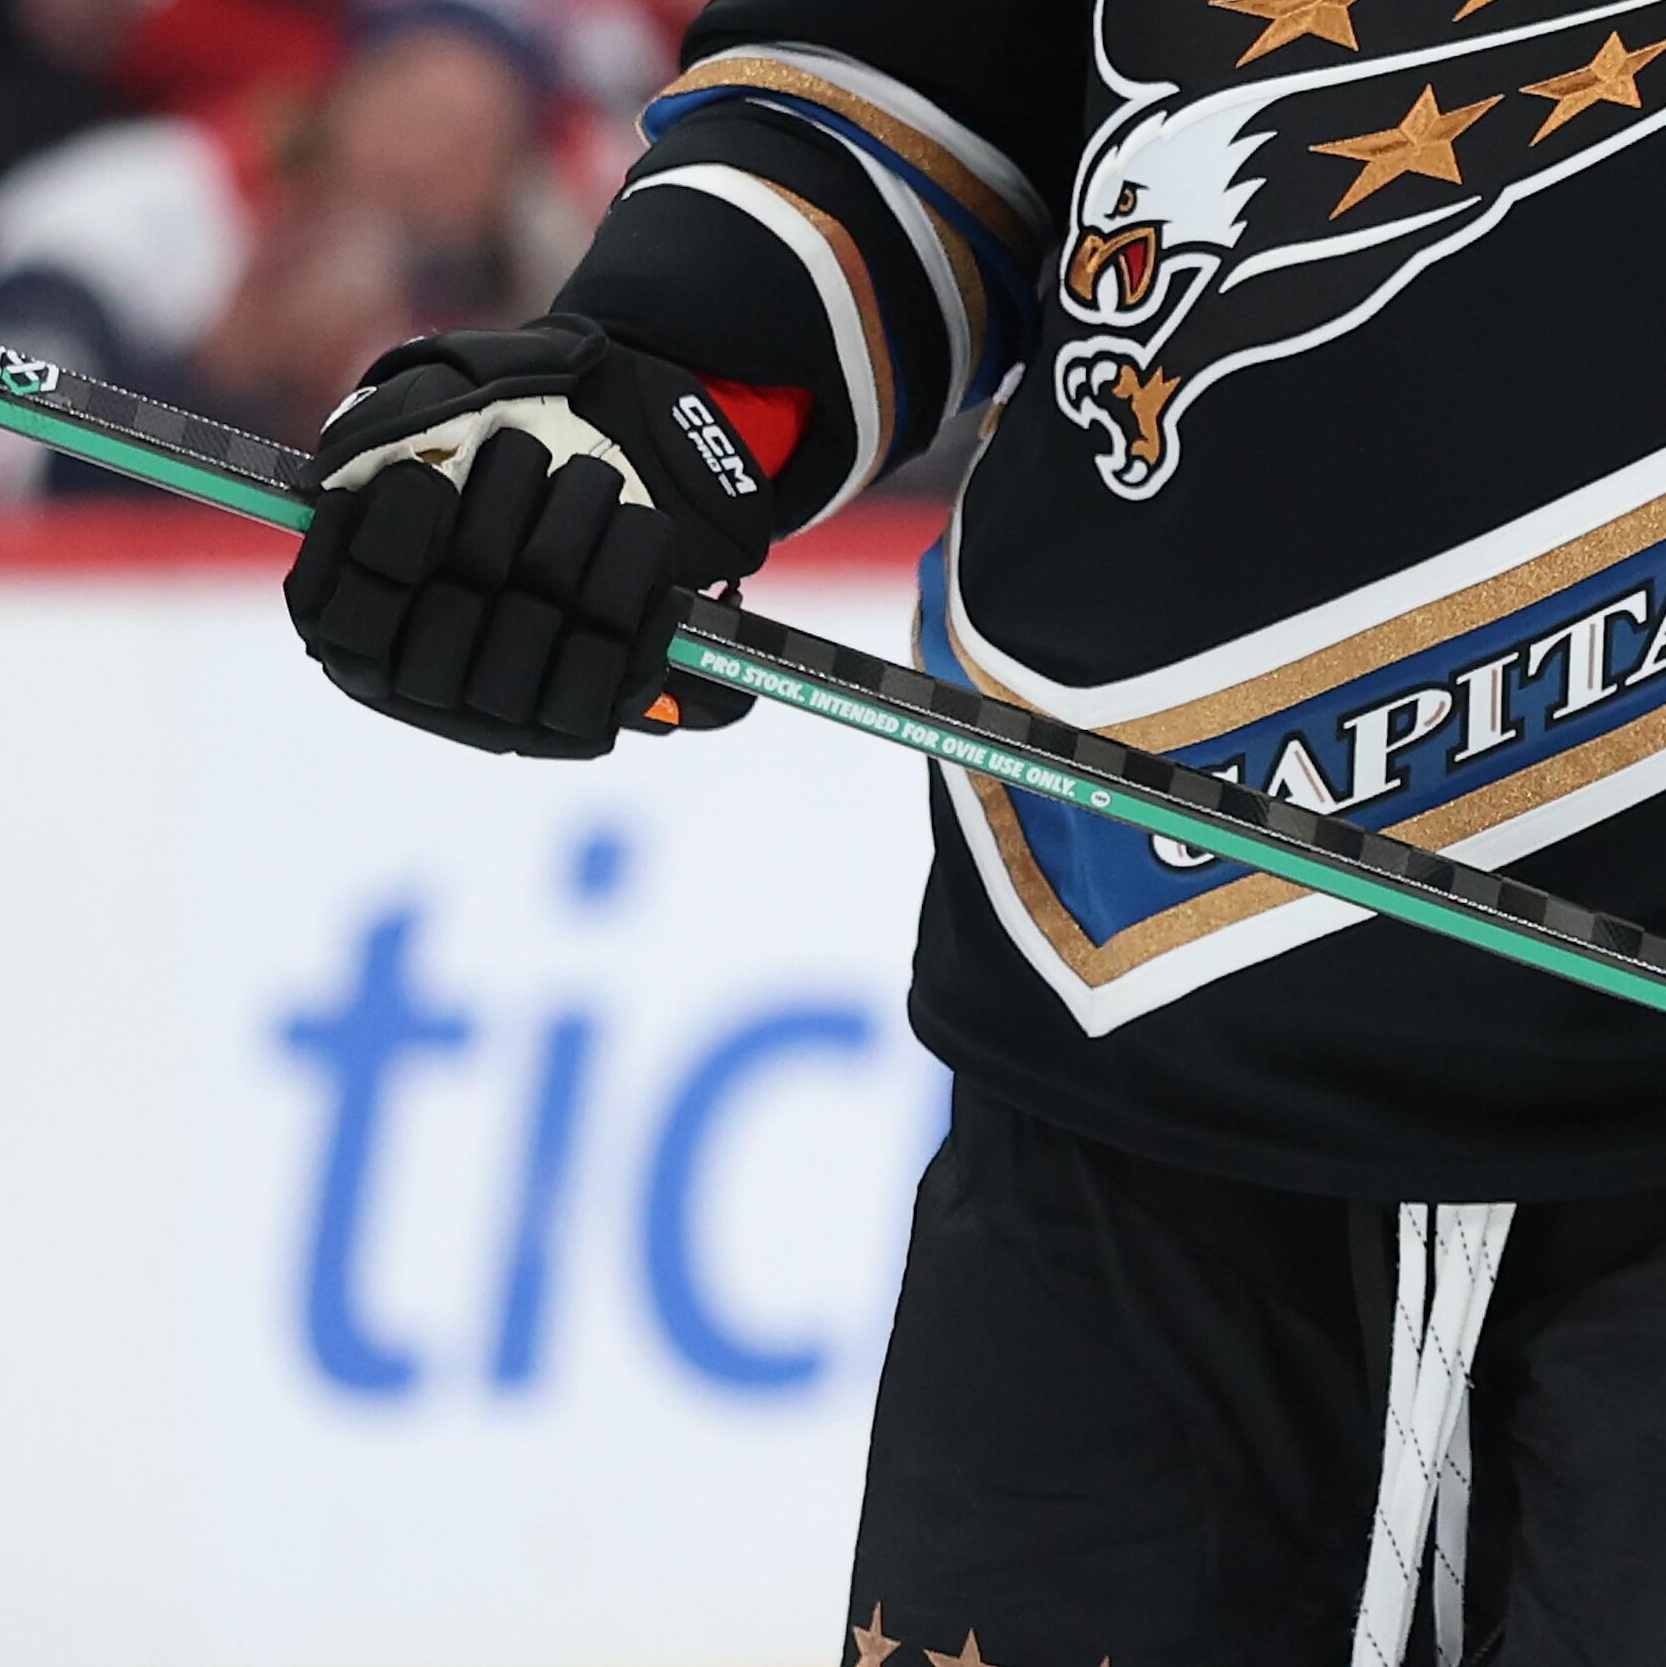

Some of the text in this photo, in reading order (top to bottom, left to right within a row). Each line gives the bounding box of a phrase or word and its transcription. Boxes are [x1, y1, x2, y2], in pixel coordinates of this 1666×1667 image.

[678, 394, 758, 494] CCM
[700, 650, 1076, 798] PRO STOCK. INTENDED FOR OVIE USE ONLY.
